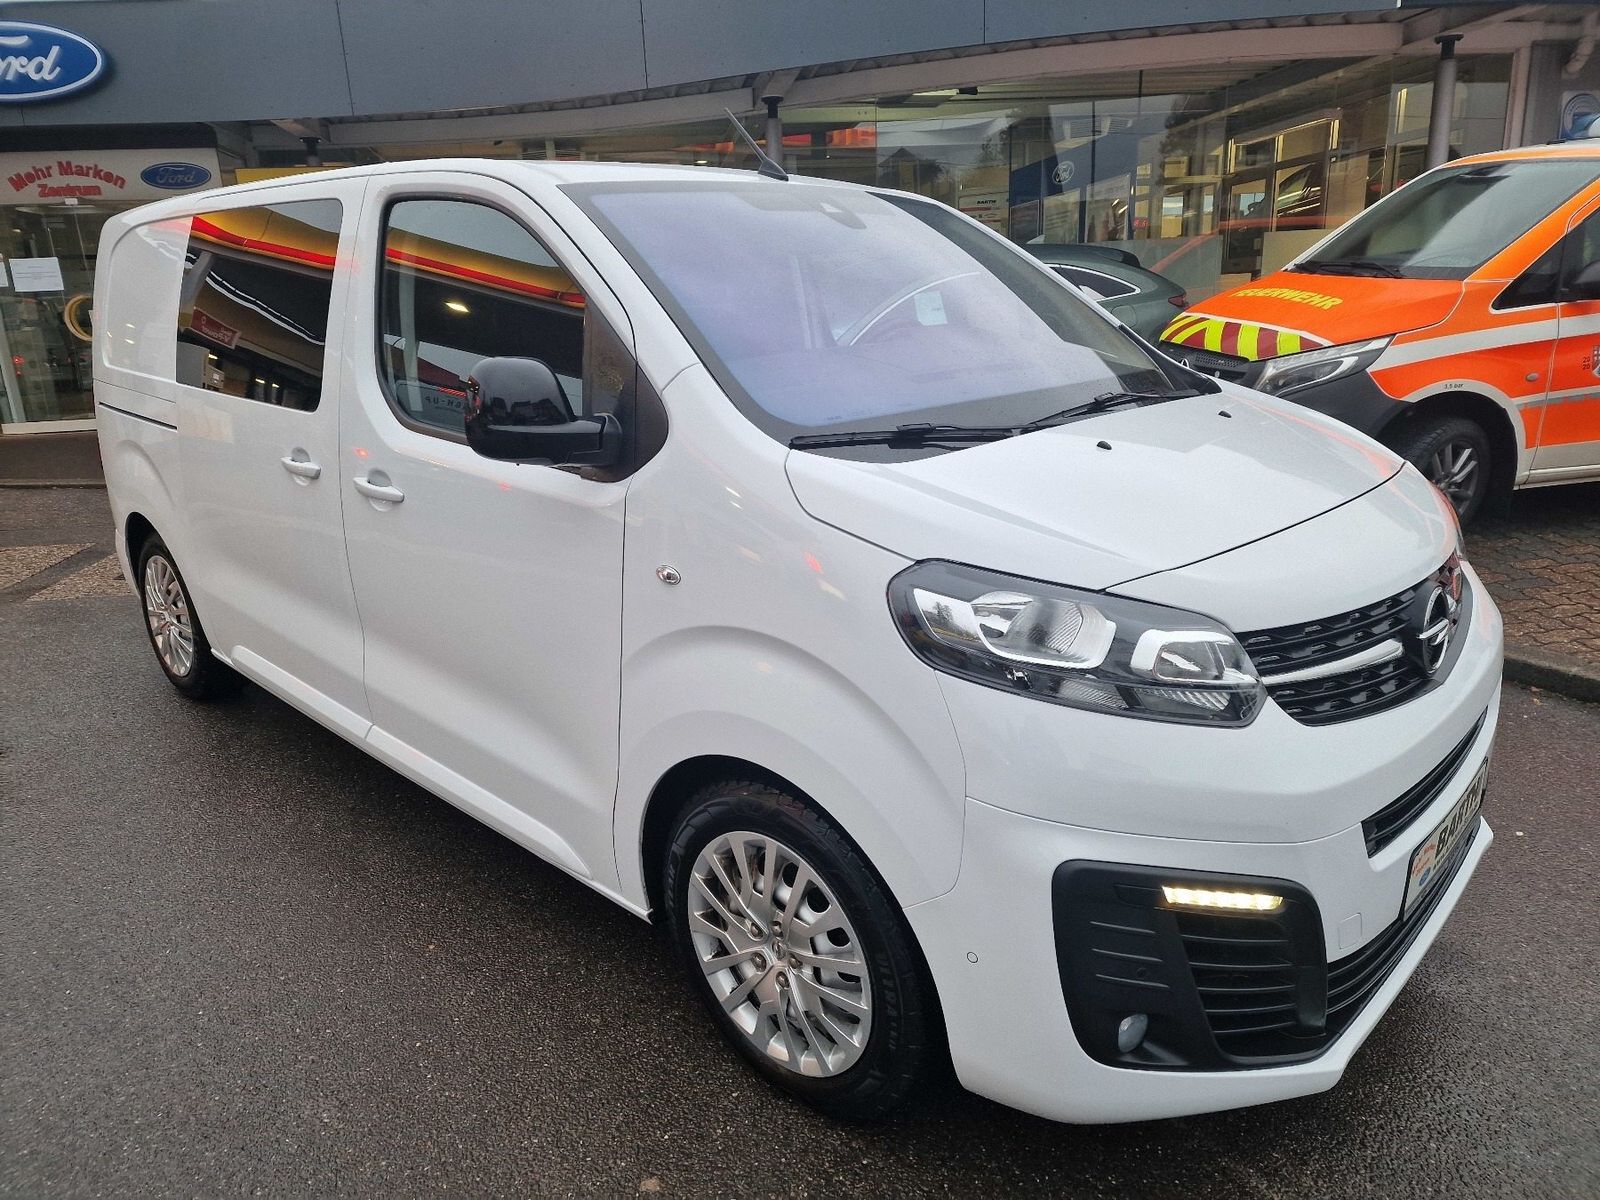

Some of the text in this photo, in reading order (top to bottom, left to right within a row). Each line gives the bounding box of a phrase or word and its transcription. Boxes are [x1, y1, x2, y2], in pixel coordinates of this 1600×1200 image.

[8, 160, 126, 192] Mehr Marken
[157, 167, 196, 183] Ford
[38, 184, 102, 197] Zentrum
[1228, 288, 1344, 310] FEUERWEHR
